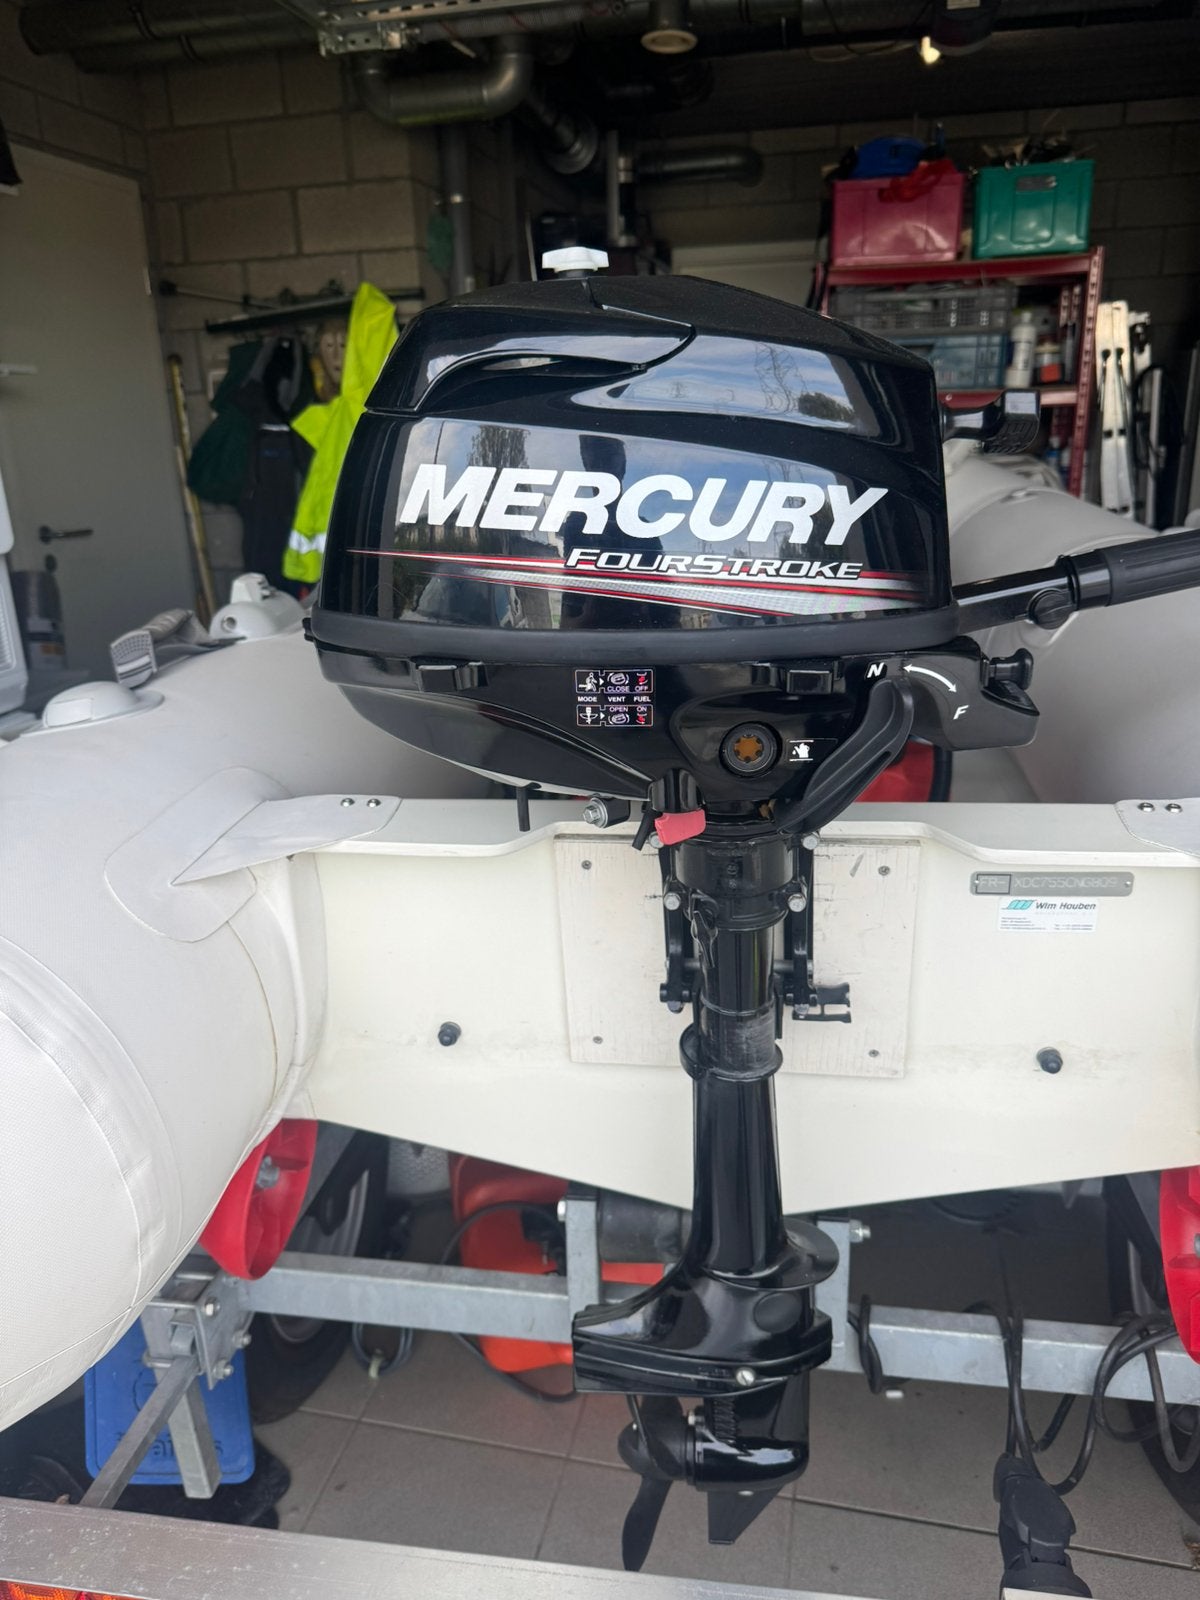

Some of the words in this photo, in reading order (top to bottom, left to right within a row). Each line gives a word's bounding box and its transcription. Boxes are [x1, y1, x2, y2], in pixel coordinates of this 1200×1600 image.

[400, 463, 888, 546] MERCURY
[564, 547, 863, 580] FOURSTROKE
[867, 662, 885, 678] N
[953, 705, 969, 720] F
[1035, 901, 1057, 910] Wim
[1059, 901, 1097, 910] Houben
